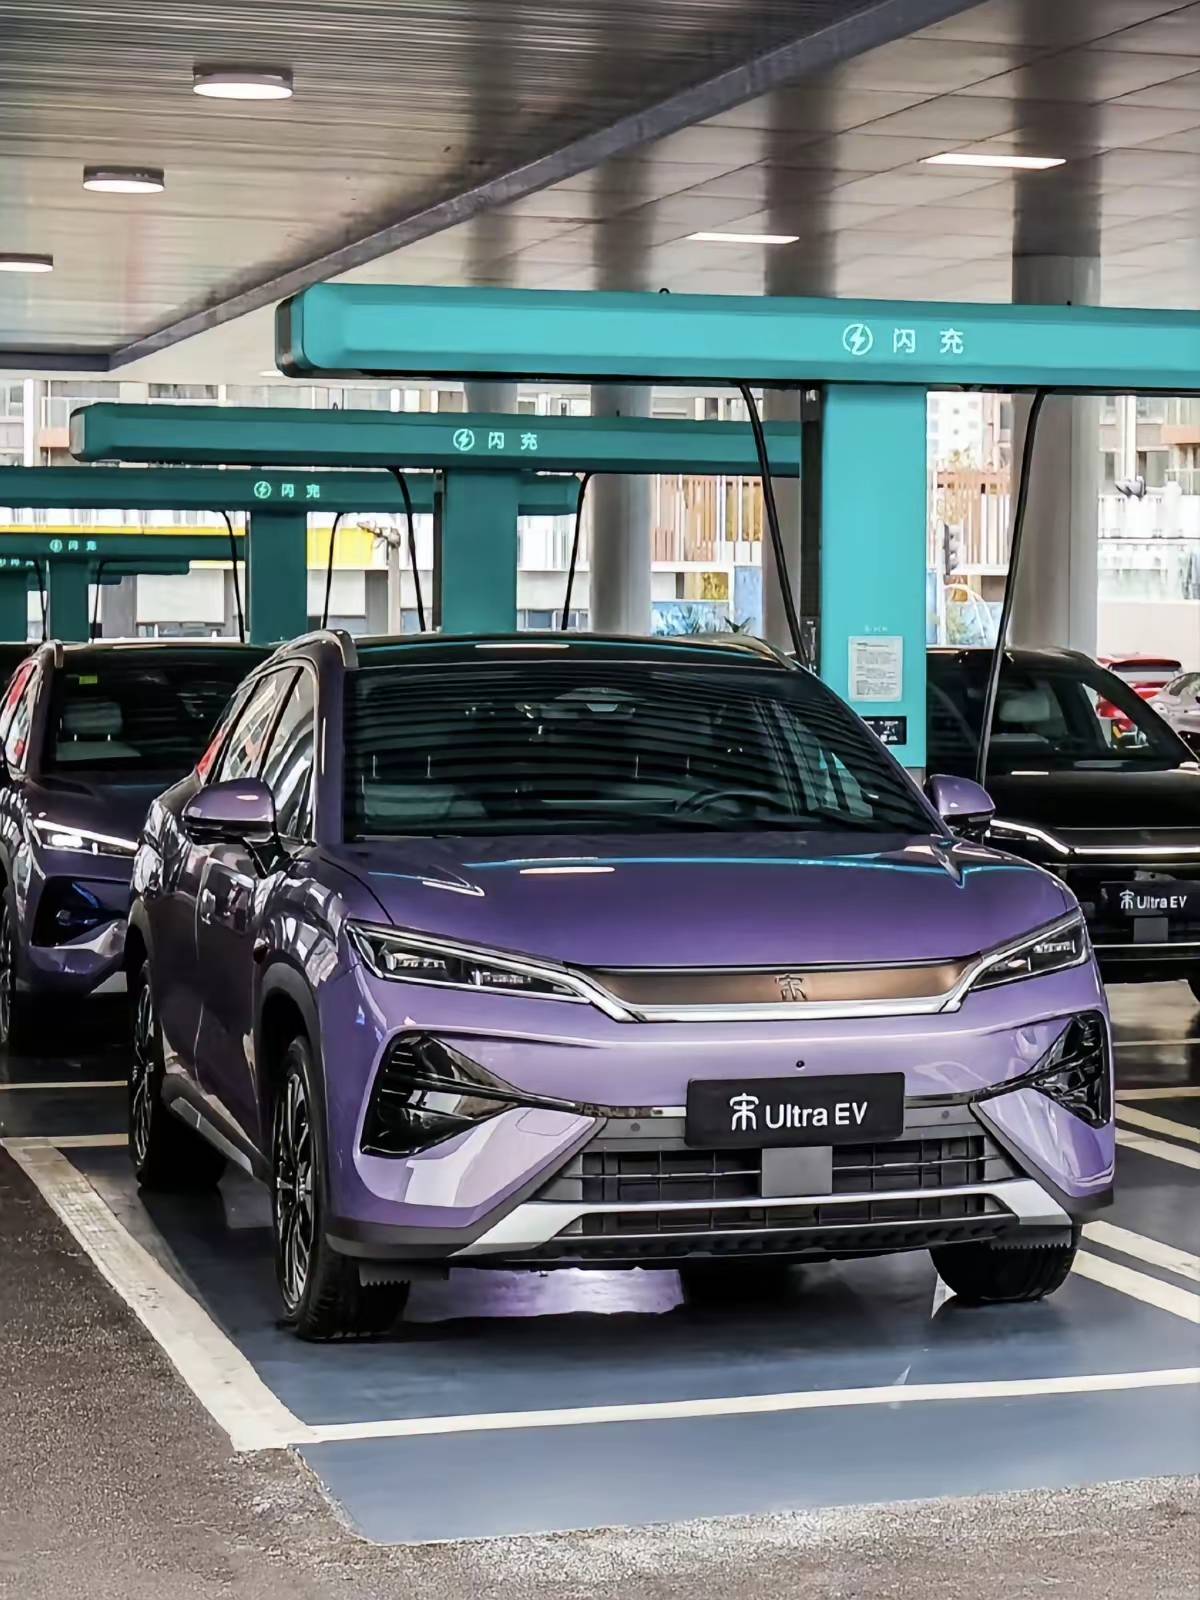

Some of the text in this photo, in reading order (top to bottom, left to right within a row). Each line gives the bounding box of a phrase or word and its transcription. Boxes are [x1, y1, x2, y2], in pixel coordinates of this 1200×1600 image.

[893, 327, 964, 354] 闪充
[488, 431, 538, 450] 闪充
[1136, 895, 1168, 909] Ultra
[1169, 895, 1187, 909] EV
[765, 1103, 828, 1129] Ultra
[834, 1101, 868, 1125] EV
